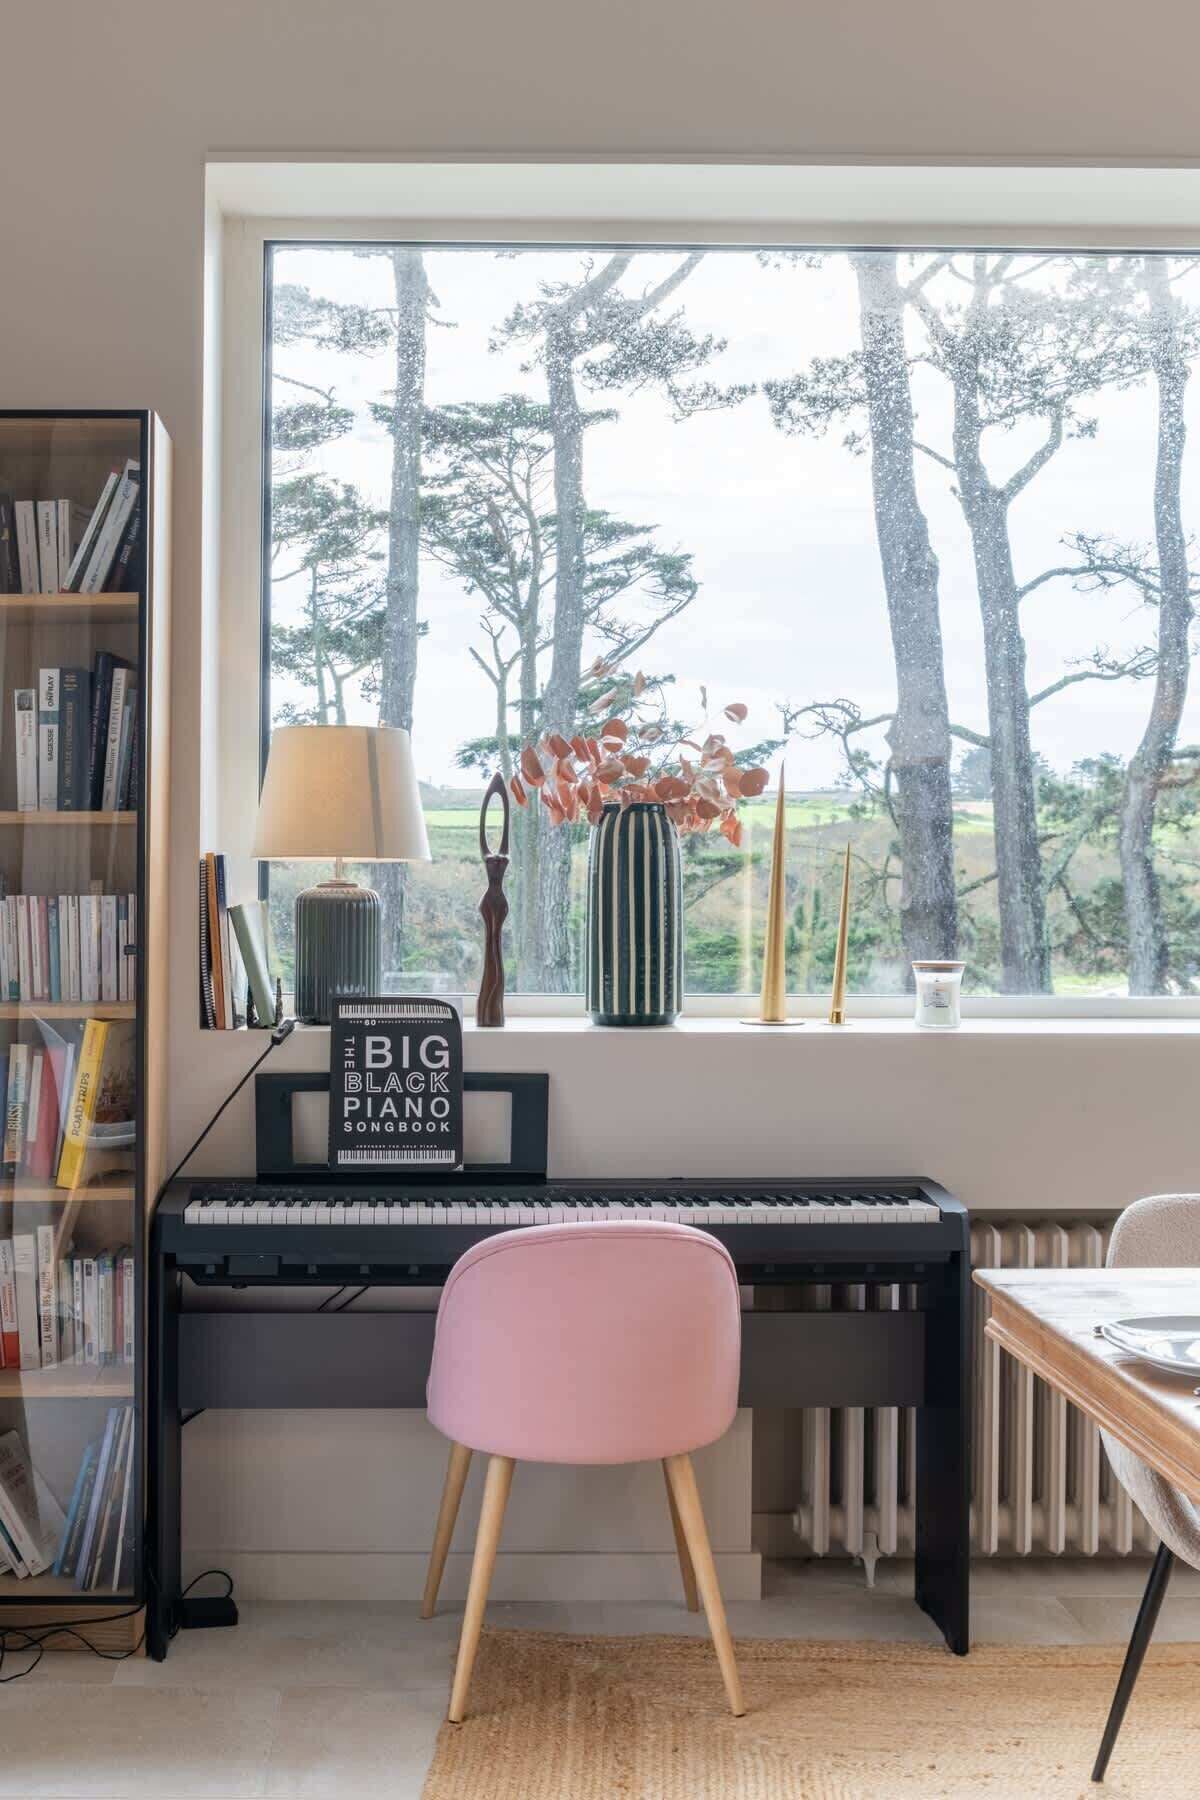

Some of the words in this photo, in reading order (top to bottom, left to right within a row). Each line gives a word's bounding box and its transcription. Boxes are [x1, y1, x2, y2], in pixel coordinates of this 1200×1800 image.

[47, 675, 55, 707] ONFRAY
[344, 1036, 356, 1069] THE
[365, 1035, 450, 1069] BIG
[344, 1072, 450, 1093] BLACK
[8, 1103, 24, 1130] BUSSI
[71, 1105, 84, 1137] ROAD
[78, 1072, 90, 1103] TRIPS
[343, 1096, 451, 1118] PIANO
[343, 1121, 450, 1133] SONGBOOK
